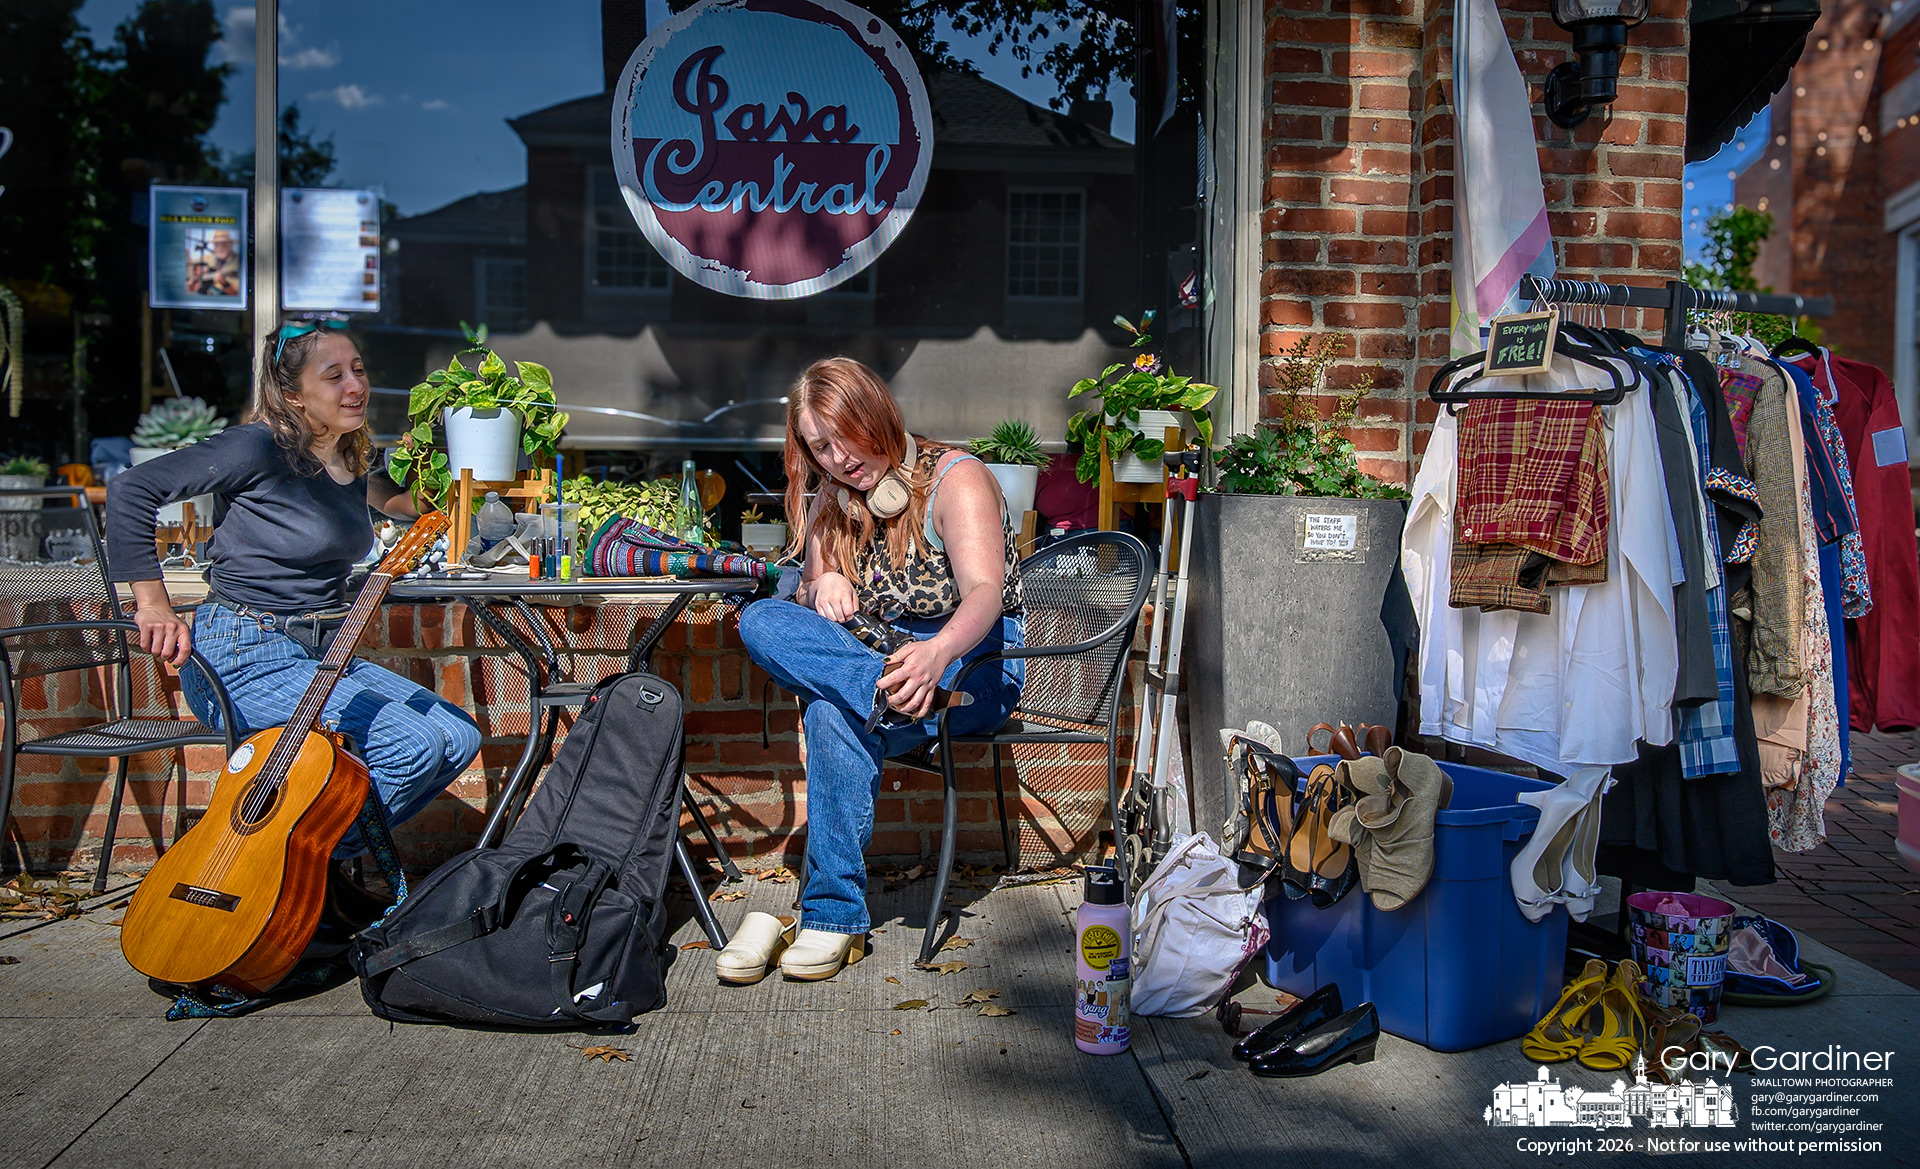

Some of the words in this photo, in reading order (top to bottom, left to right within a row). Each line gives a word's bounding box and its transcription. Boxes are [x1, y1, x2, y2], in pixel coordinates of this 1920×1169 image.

[672, 45, 860, 152] Java
[642, 138, 892, 215] Central
[1496, 340, 1544, 365] FREE!
[1323, 516, 1341, 525] STAFF
[1326, 539, 1337, 547] TO!
[1083, 1004, 1108, 1018] gang
